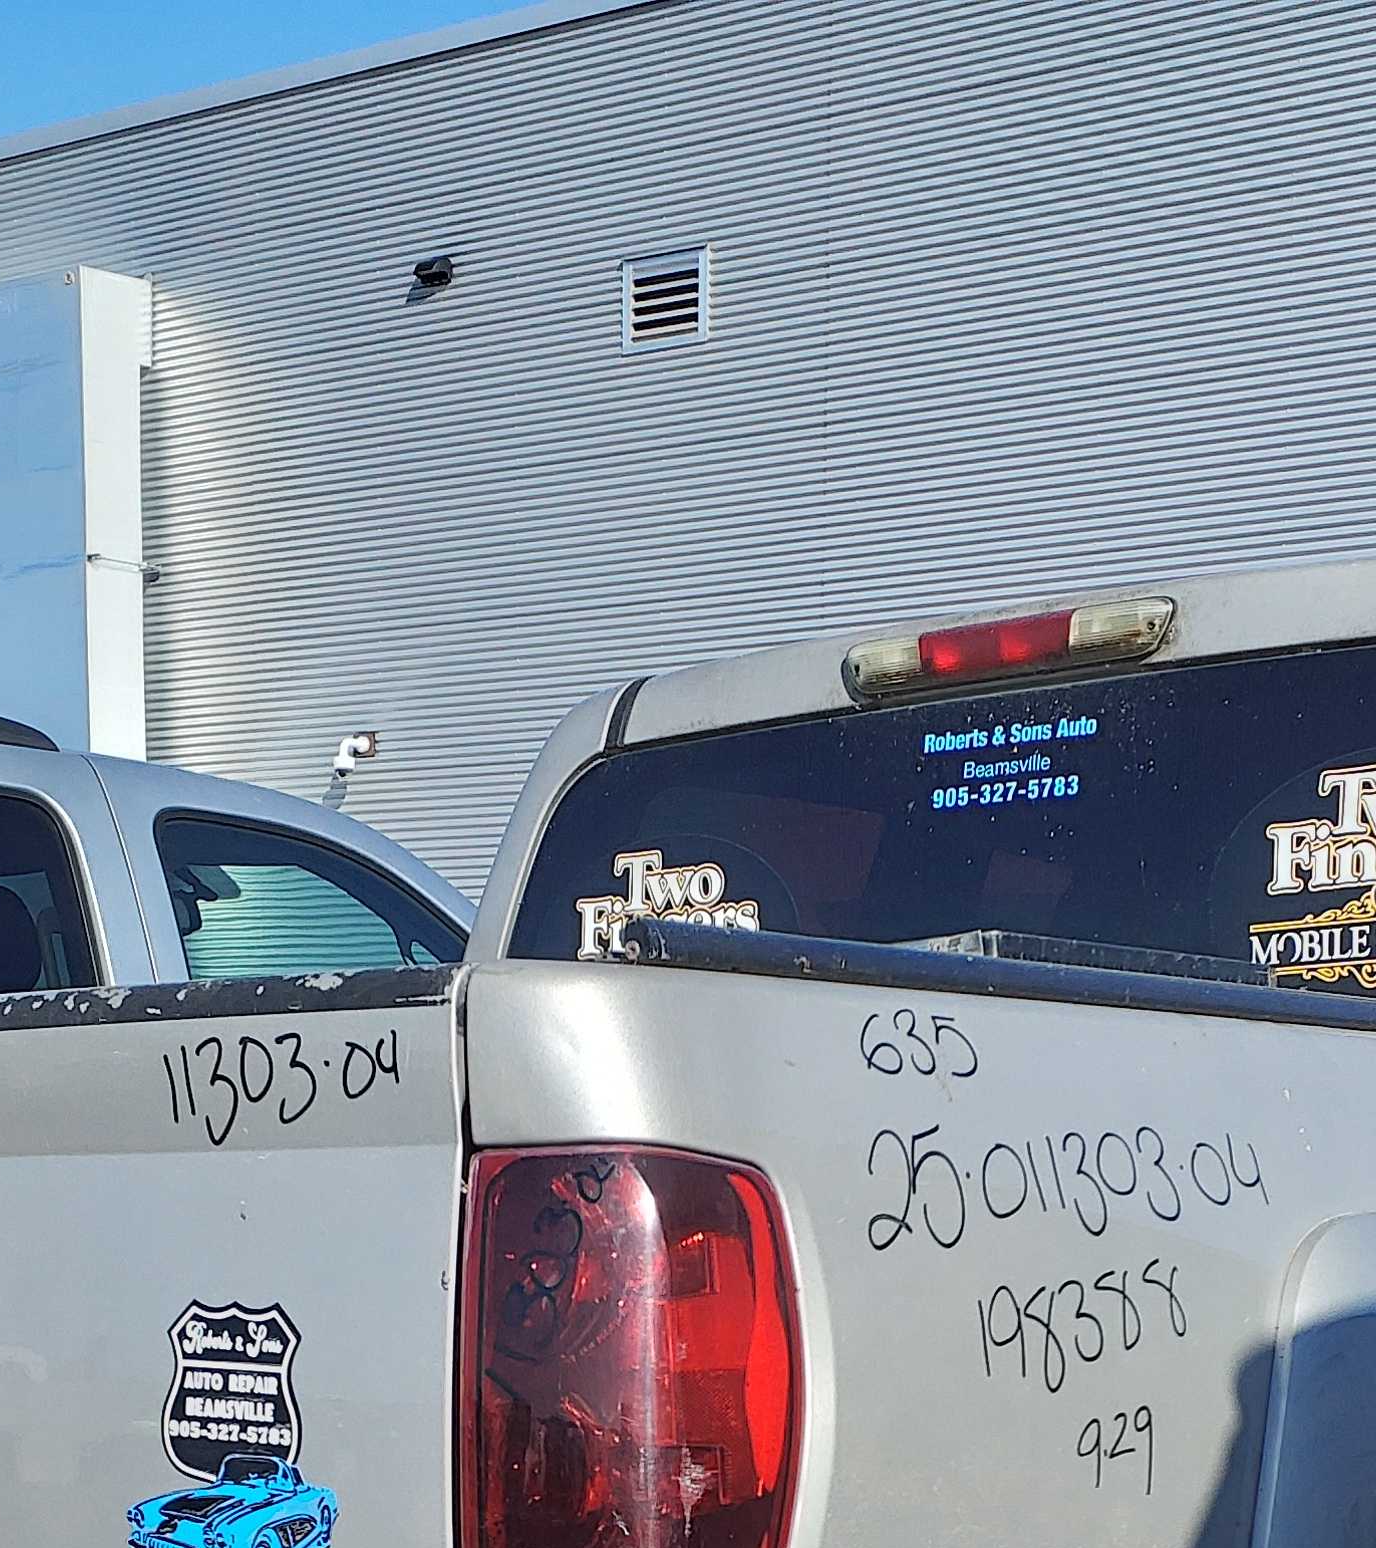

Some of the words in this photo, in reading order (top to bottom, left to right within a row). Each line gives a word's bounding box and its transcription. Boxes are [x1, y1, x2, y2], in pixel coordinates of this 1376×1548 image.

[923, 729, 988, 754] Roberts
[991, 724, 1006, 746] &
[1009, 722, 1053, 744] Sons
[1055, 714, 1098, 739] Auto
[963, 753, 1052, 779] Beamsville
[932, 775, 1080, 809] 905-327-5783
[613, 849, 726, 914] Two
[1249, 923, 1372, 966] MOBILE
[860, 1008, 979, 1078] 635
[977, 1258, 1189, 1393] 198388
[182, 1370, 224, 1391] AUTO
[227, 1373, 279, 1395] REPAIR
[184, 1396, 275, 1423] BEAMSVILLE
[167, 1418, 293, 1447] 905-327-5783
